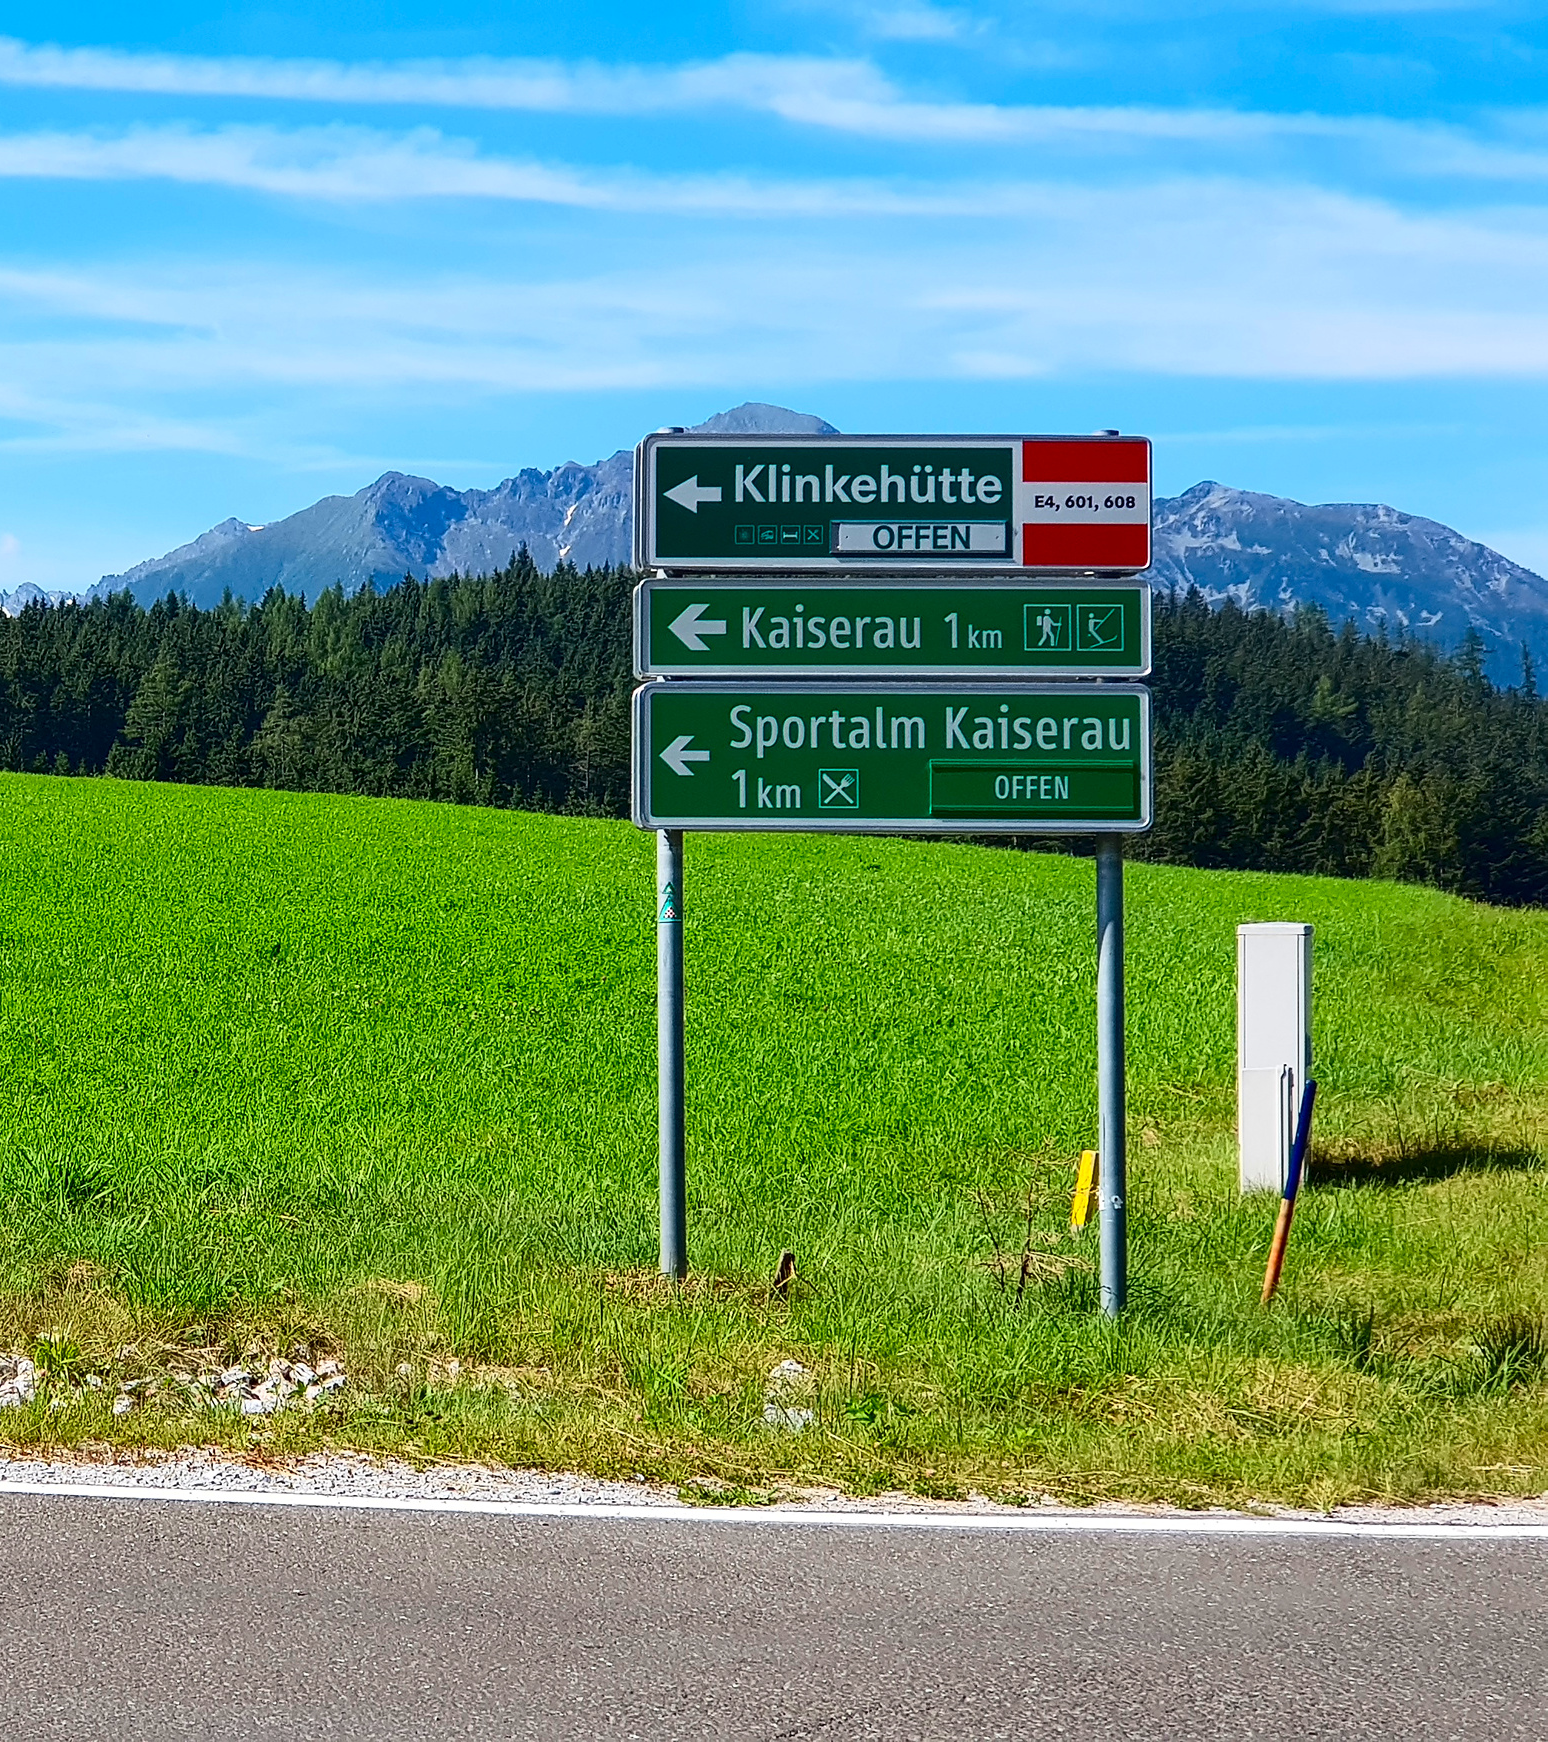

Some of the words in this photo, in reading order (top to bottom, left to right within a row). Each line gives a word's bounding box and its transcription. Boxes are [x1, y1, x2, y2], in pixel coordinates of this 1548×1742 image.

[735, 463, 1003, 504] Klinkehütte
[1034, 494, 1061, 512] E4,
[1064, 495, 1100, 512] 601,
[1103, 495, 1136, 510] 608
[872, 525, 971, 550] OFFEN
[742, 604, 922, 649] Kaiserau
[943, 612, 959, 649] 1
[968, 625, 1003, 649] km
[729, 704, 926, 759] Sportalm
[945, 704, 1131, 751] Kaiserau
[731, 769, 747, 809] 1
[757, 777, 801, 809] km
[994, 776, 1069, 800] OFFEN
